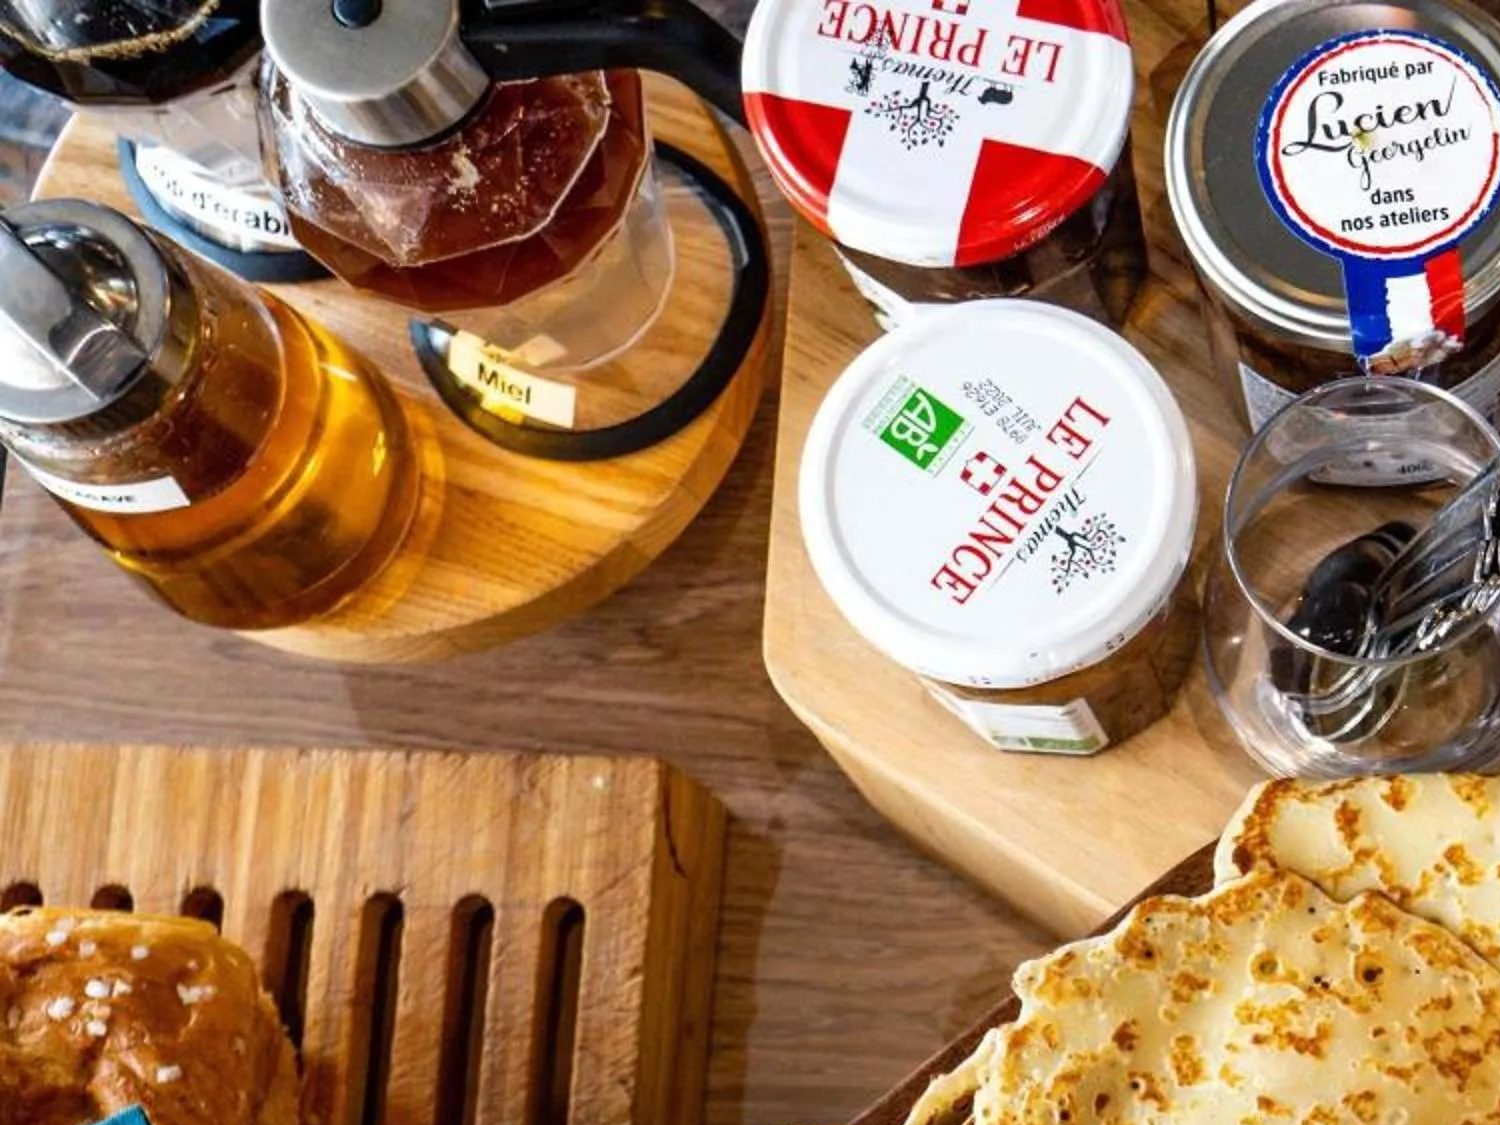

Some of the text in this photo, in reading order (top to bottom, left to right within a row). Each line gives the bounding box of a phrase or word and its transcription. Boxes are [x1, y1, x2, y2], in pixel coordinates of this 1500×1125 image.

[817, 0, 1064, 82] LE PRINCE
[1318, 60, 1435, 86] Fabriqué par
[881, 56, 982, 96] Thomas
[1281, 75, 1457, 157] Lucien
[1347, 124, 1472, 191] Georgelin
[1341, 206, 1449, 232] nos ateliers
[1370, 187, 1415, 205] dans
[478, 362, 531, 405] Miel
[1046, 396, 1111, 460] LE
[930, 453, 1066, 605] PRINCE
[1014, 484, 1087, 564] Thomas
